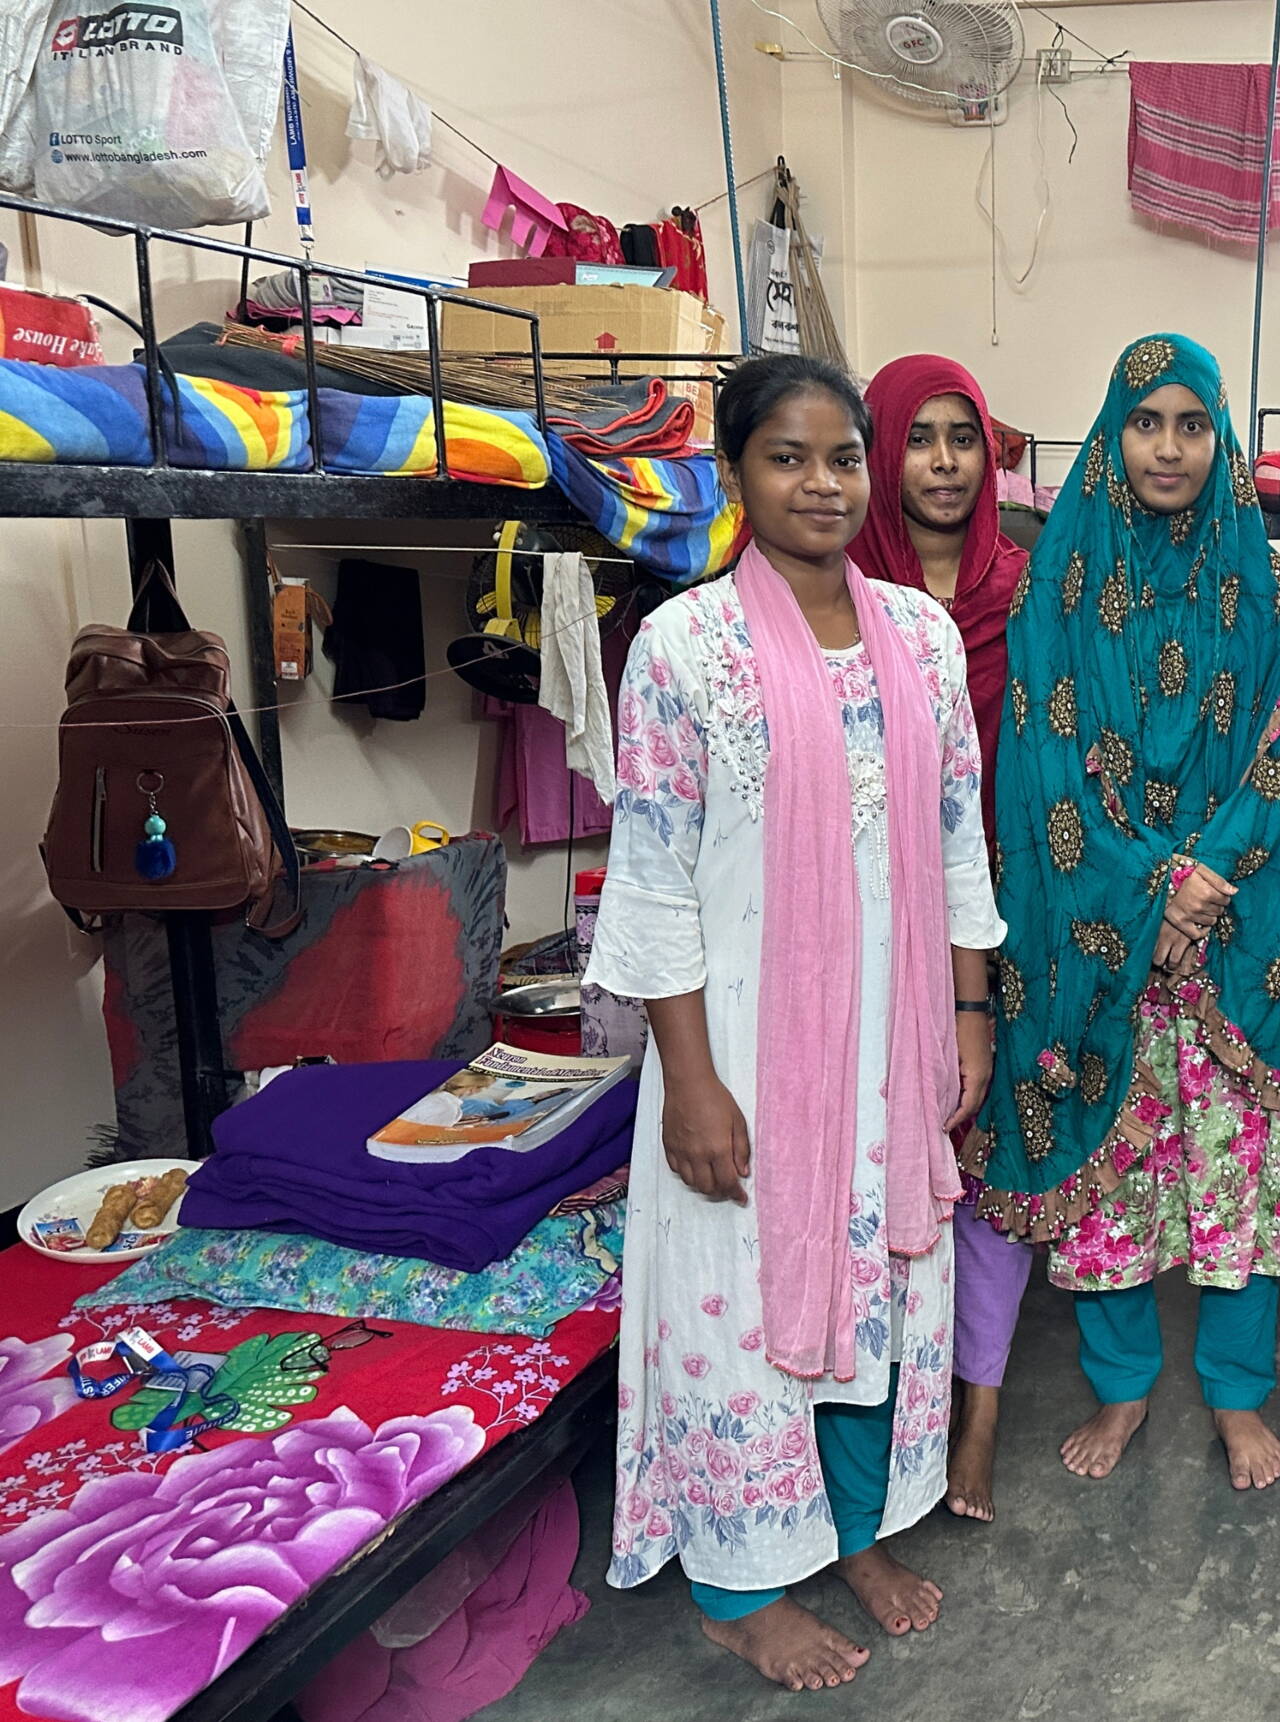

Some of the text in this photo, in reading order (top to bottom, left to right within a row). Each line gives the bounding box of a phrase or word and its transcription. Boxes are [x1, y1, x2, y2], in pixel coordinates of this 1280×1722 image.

[120, 41, 182, 56] BRAND
[61, 134, 122, 147] LOTTO Sport
[65, 149, 208, 164] www.lottobangladesh.com
[12, 327, 68, 355] House
